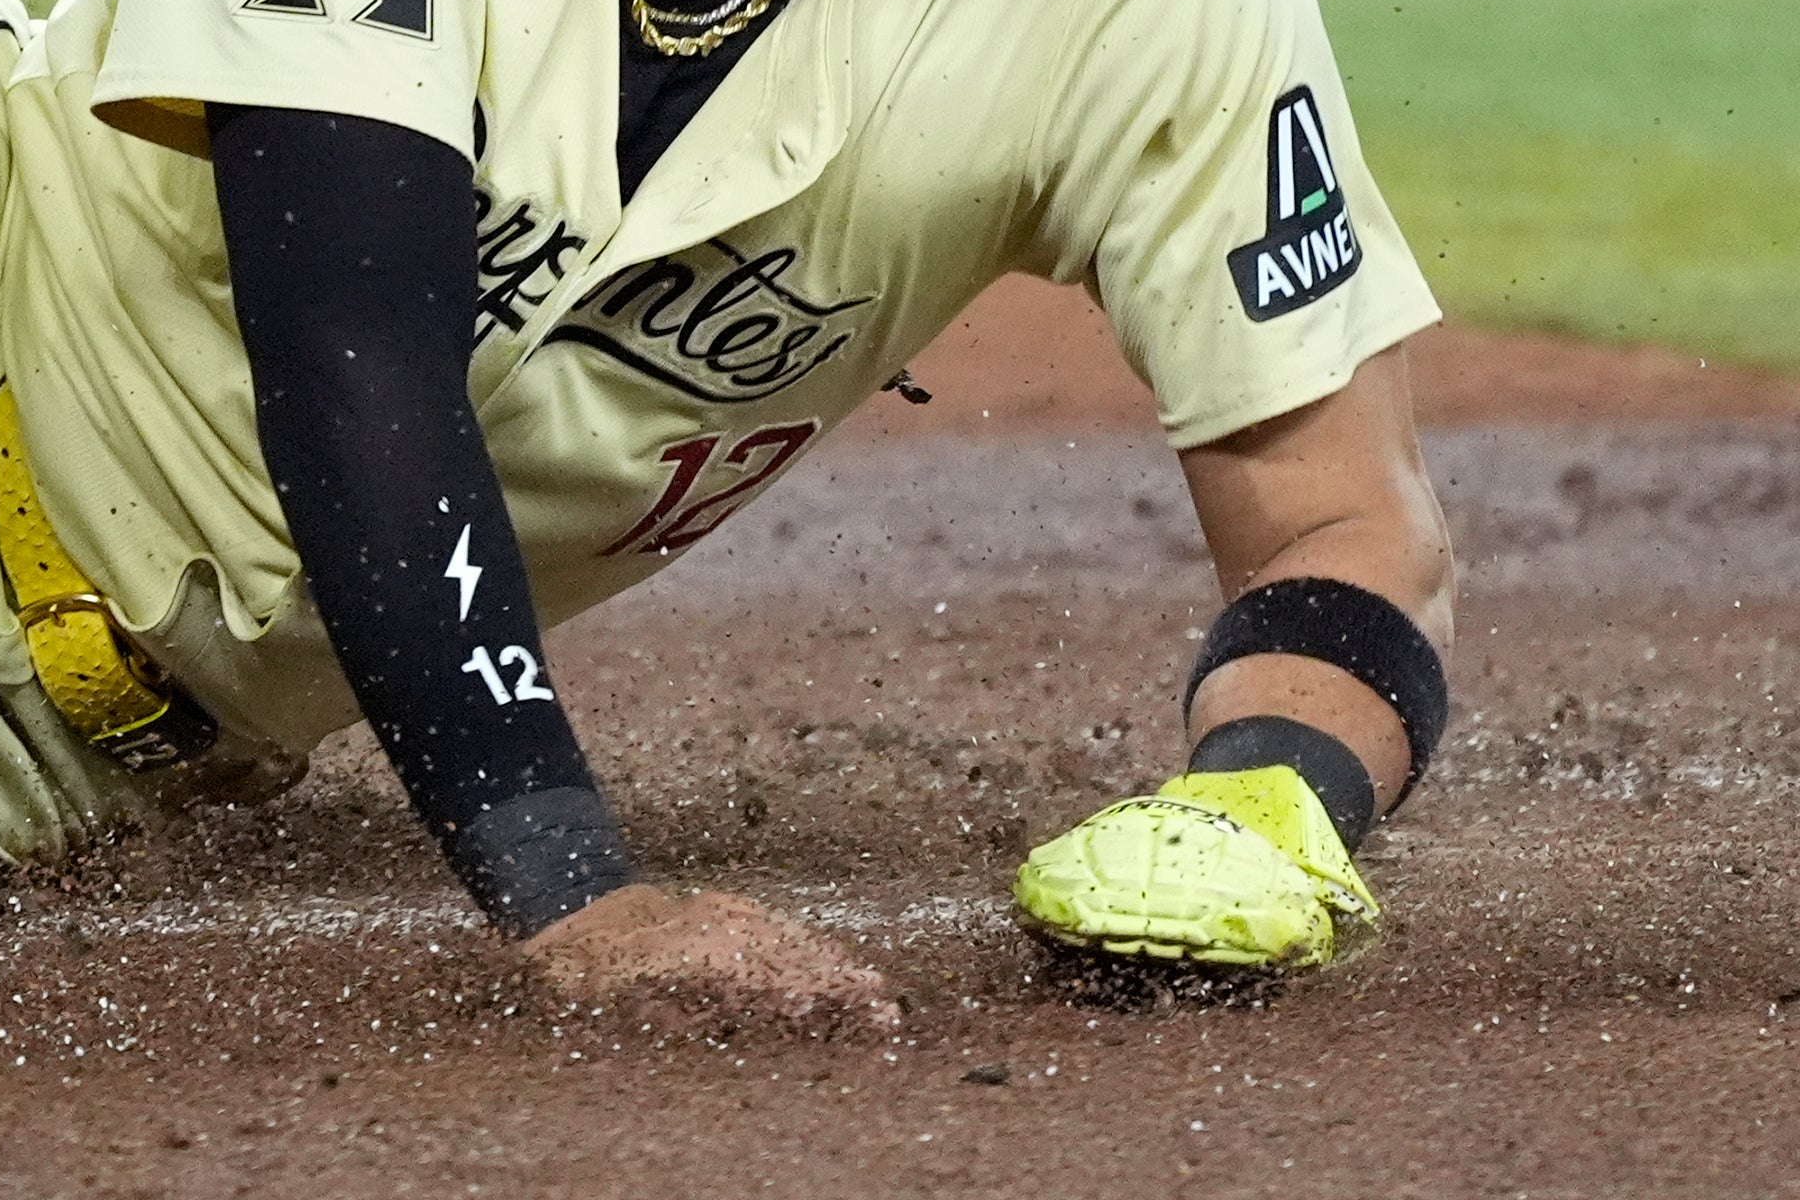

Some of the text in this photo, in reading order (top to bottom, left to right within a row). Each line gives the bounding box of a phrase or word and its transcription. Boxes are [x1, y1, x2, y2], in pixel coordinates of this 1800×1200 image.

[1256, 204, 1357, 307] AVNE
[598, 417, 822, 557] 12
[460, 645, 555, 705] 12
